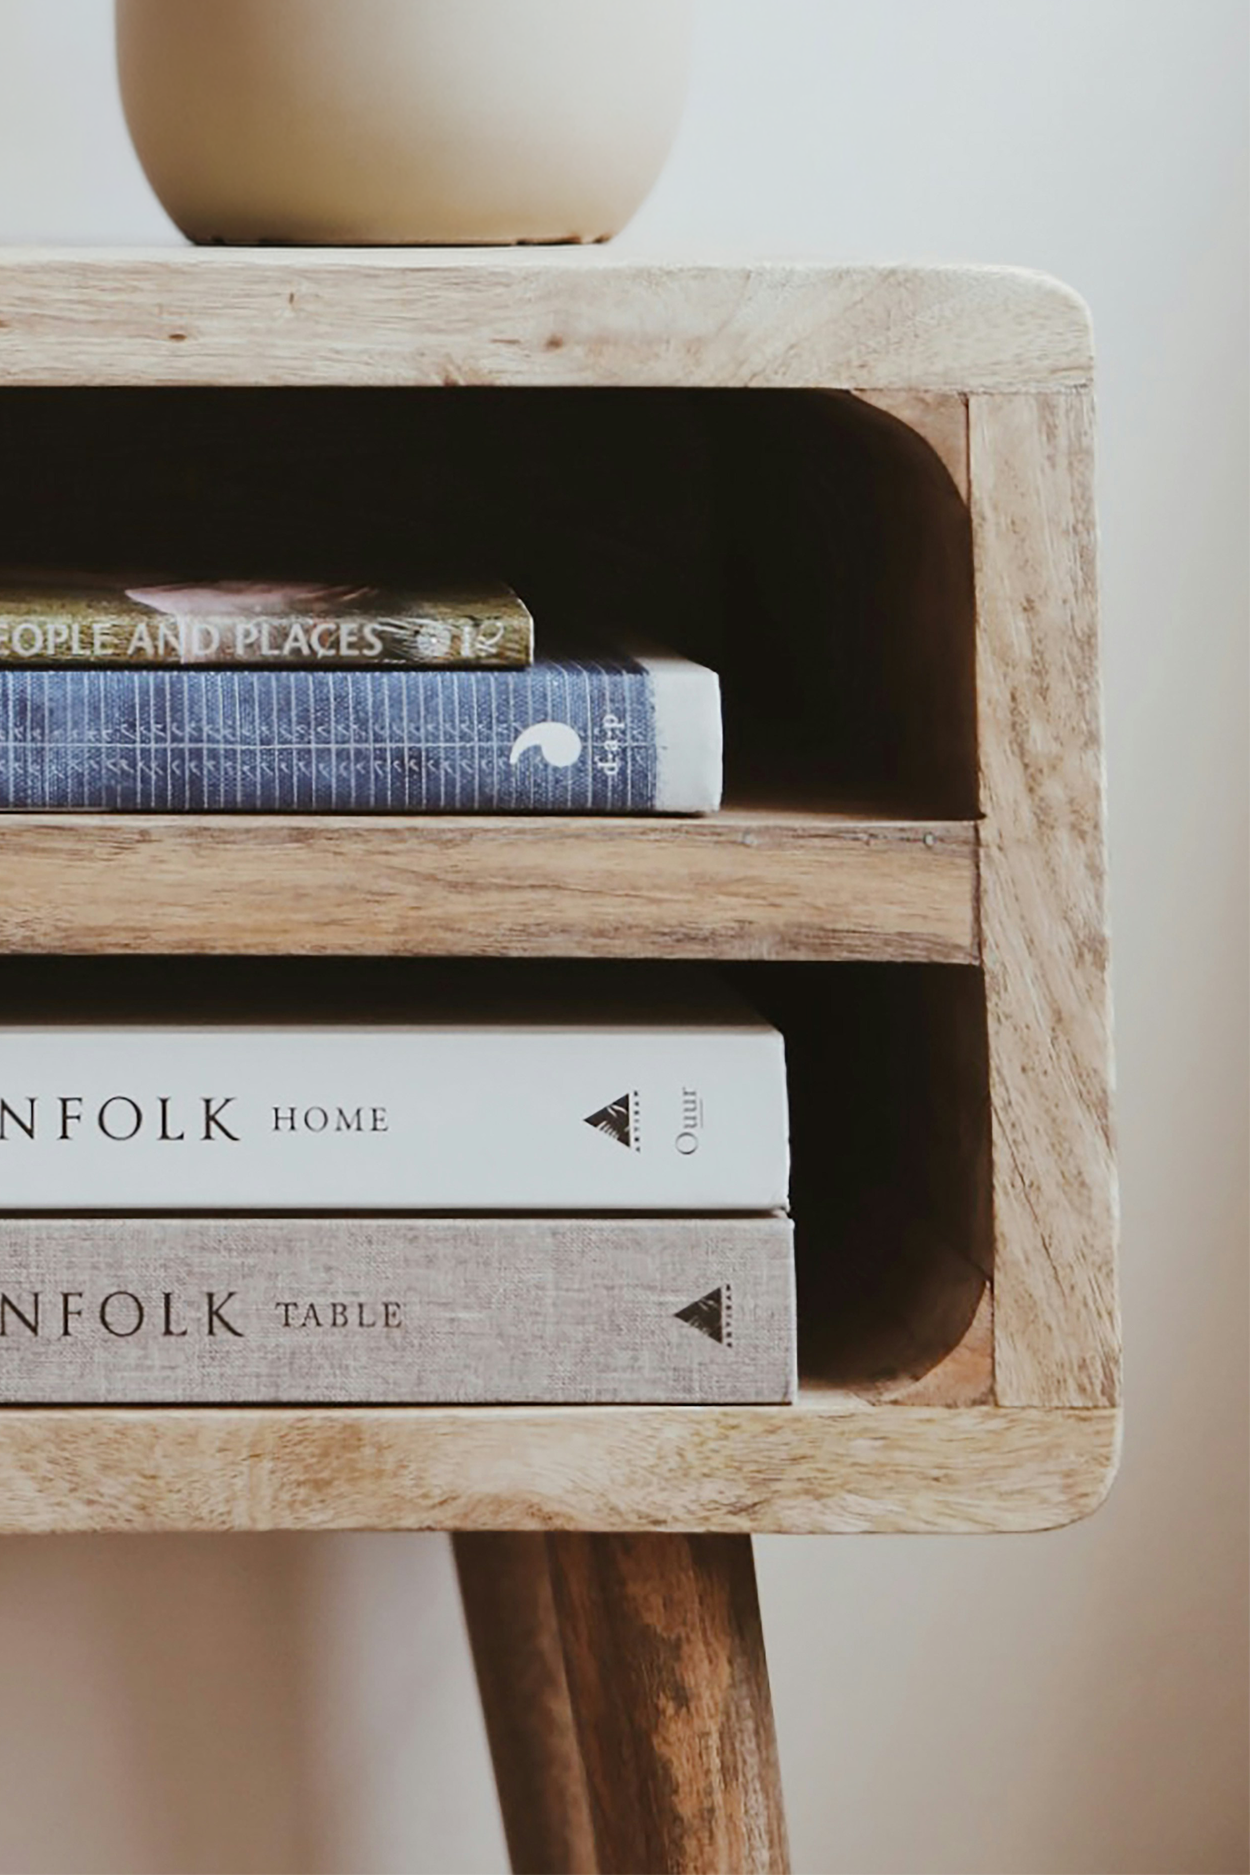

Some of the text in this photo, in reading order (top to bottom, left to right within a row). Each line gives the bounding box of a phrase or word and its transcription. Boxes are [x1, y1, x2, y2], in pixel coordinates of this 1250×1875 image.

[127, 623, 221, 658] AND
[235, 623, 384, 658] PLACES
[272, 1105, 390, 1133] HOME
[275, 1301, 403, 1329] TABLE
